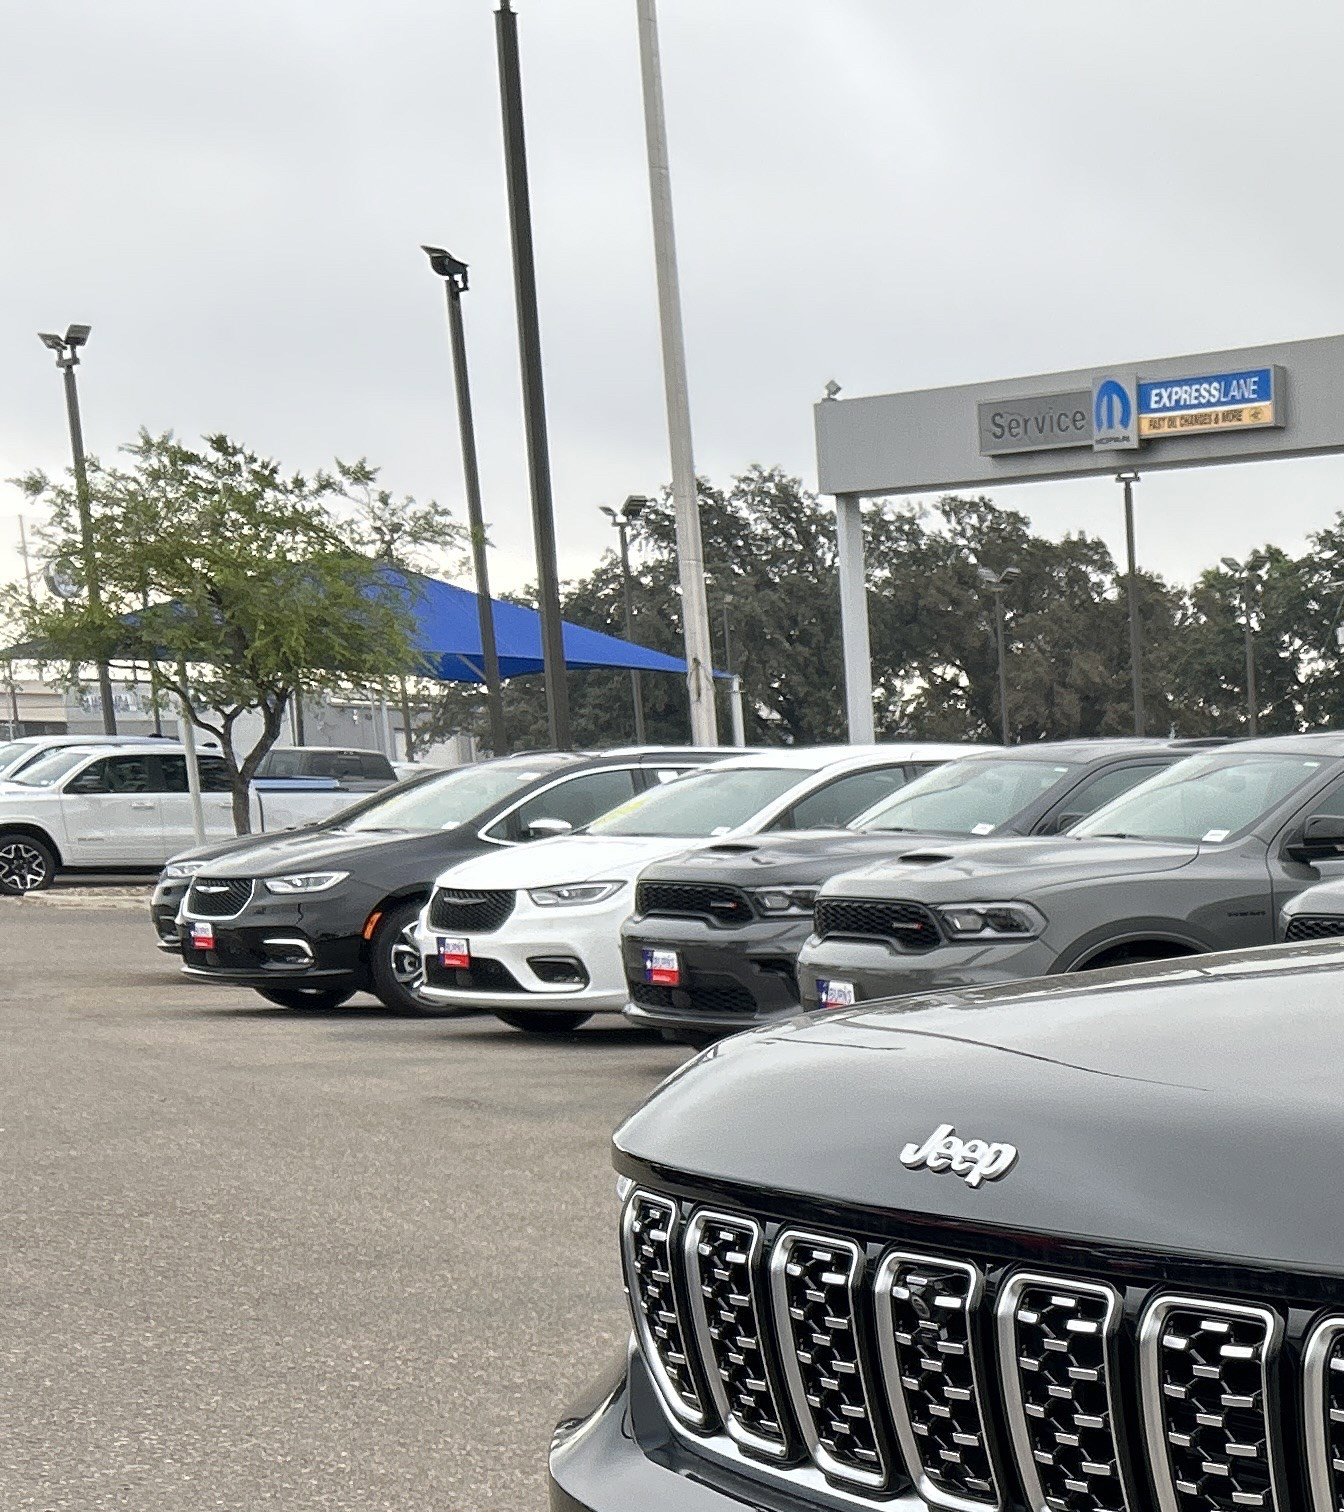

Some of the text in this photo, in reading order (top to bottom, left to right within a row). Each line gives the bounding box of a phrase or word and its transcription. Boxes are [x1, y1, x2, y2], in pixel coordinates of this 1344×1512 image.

[1150, 377, 1259, 408] EXPRESSLANE
[991, 406, 1087, 440] Service
[900, 1124, 1020, 1189] Jeep
